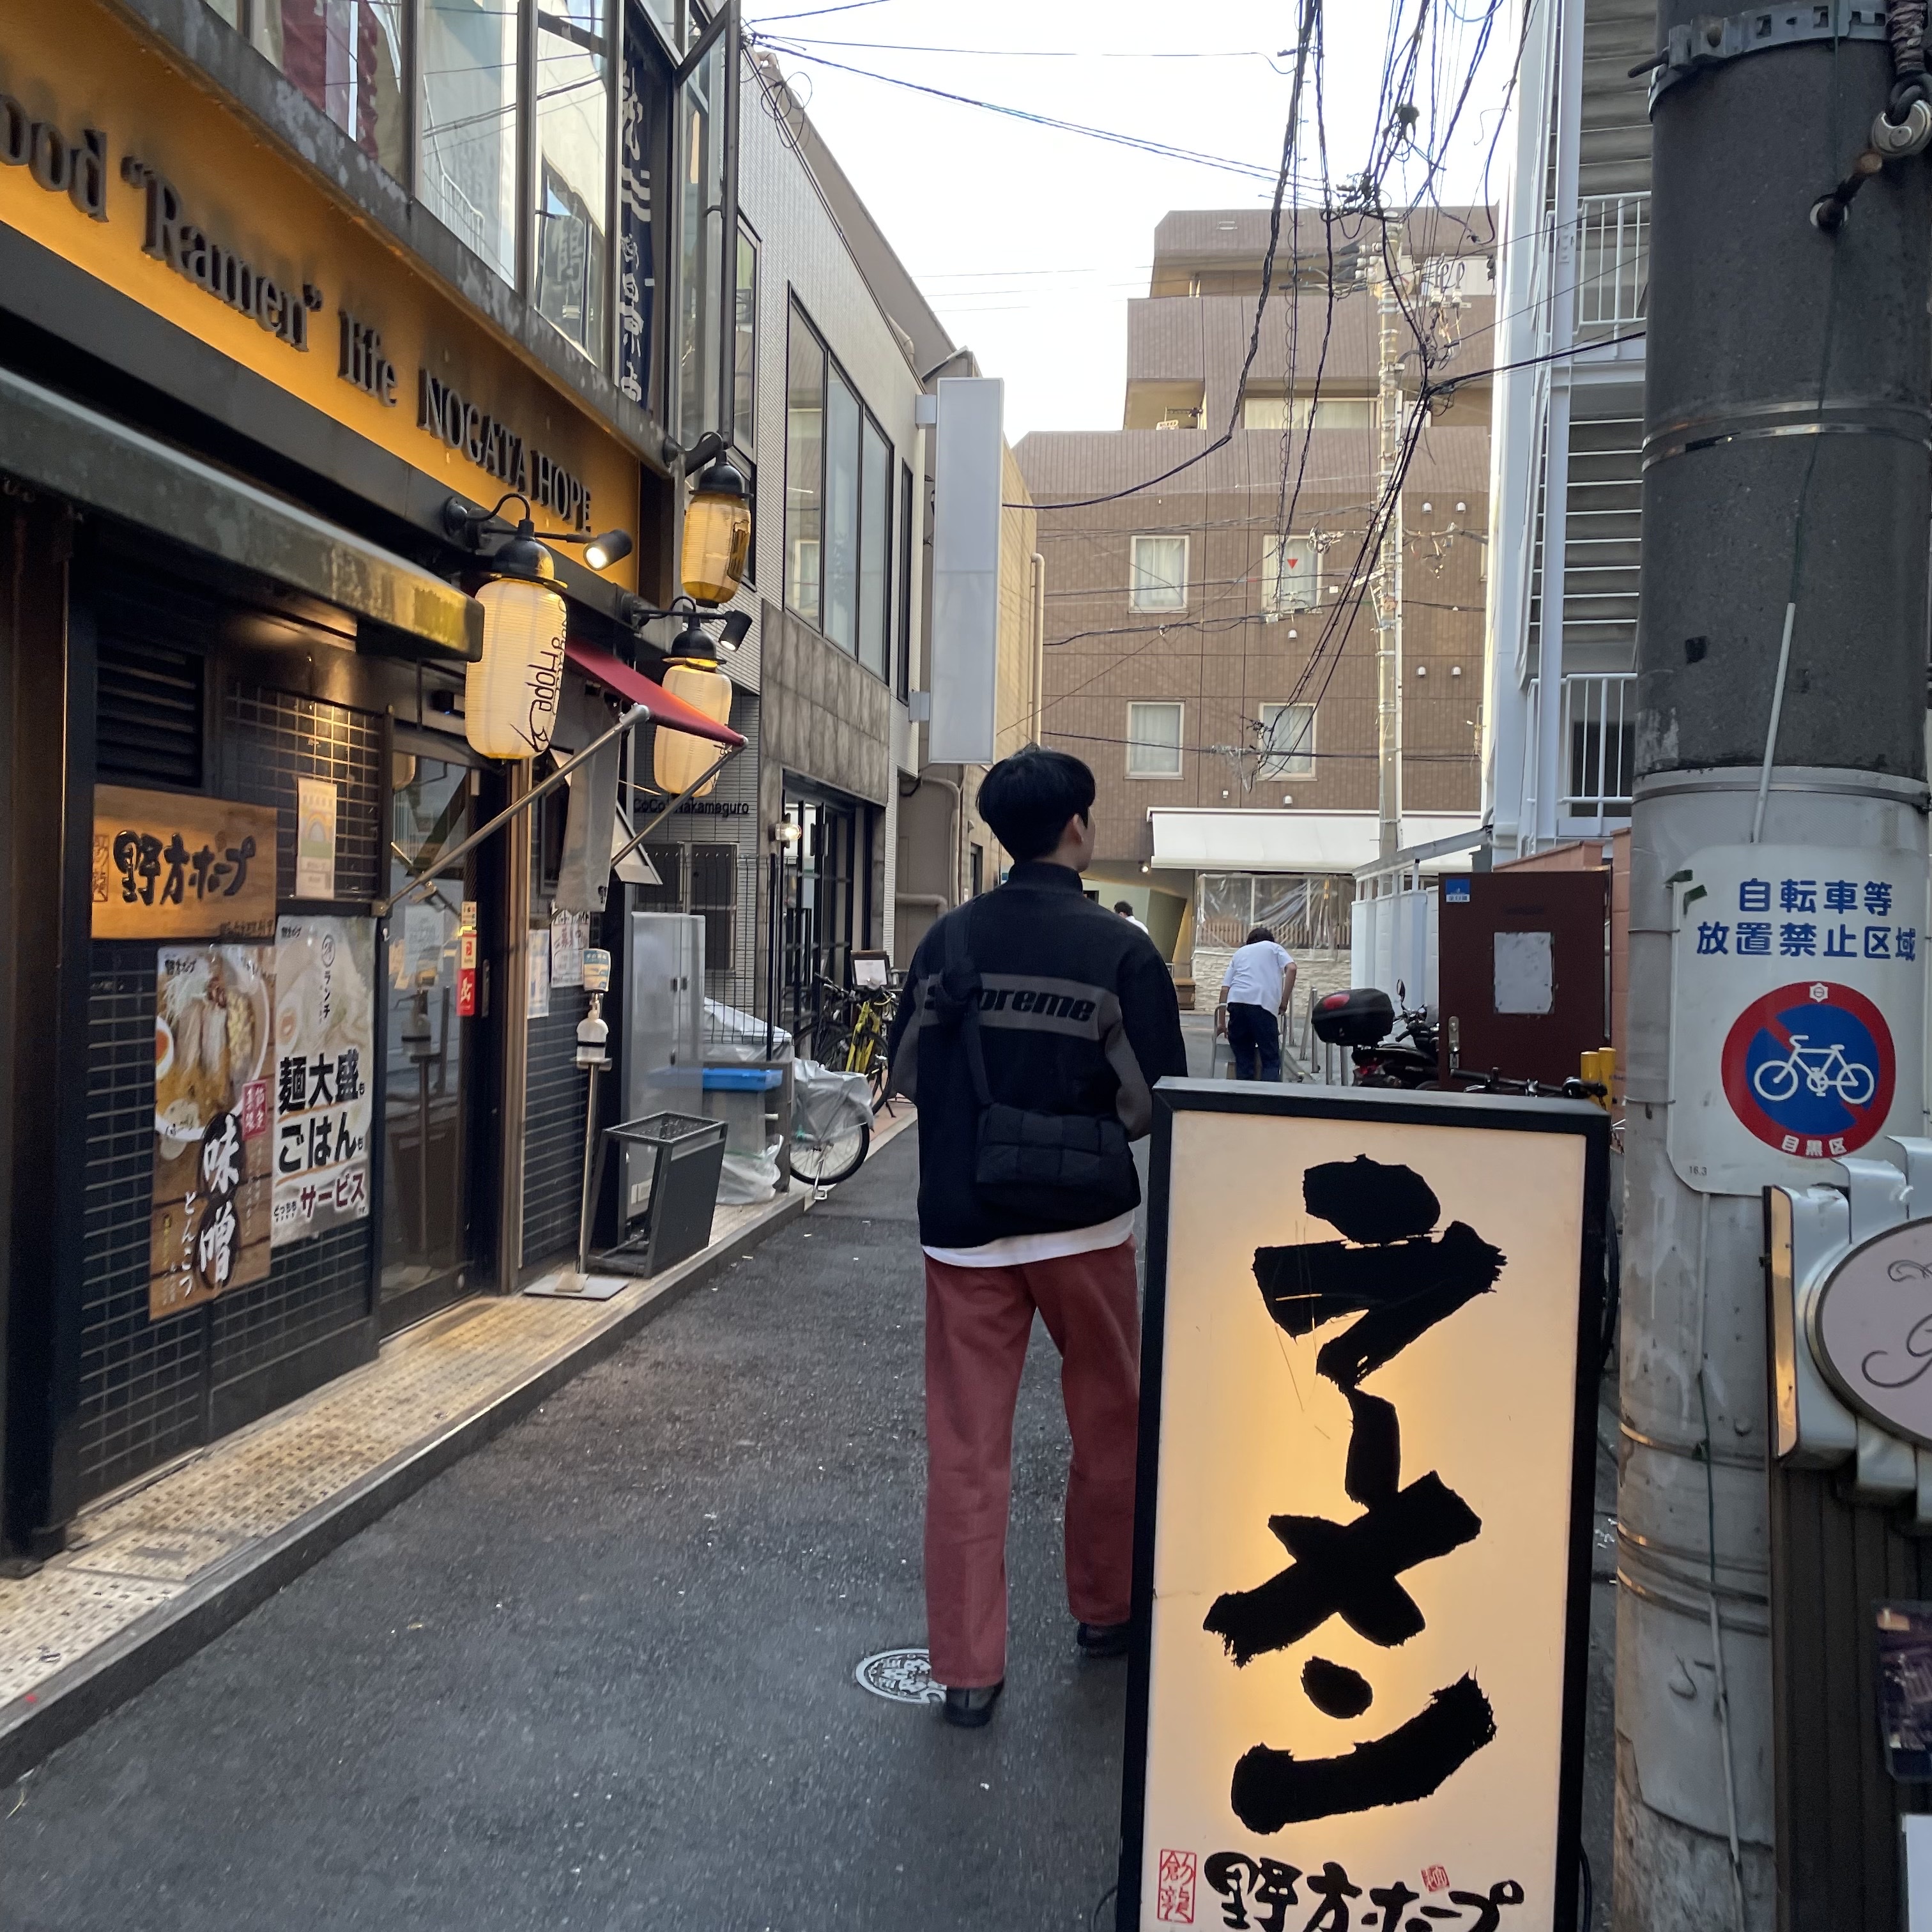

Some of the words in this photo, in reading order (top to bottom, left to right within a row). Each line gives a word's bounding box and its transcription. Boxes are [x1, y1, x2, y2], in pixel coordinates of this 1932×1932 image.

[337, 309, 398, 408] life
[417, 368, 531, 497] NOGATA
[530, 450, 591, 536] HOPE
[113, 830, 256, 906] 野方ホープ
[1739, 878, 1892, 917] 自転車等
[1697, 921, 1916, 961] 放置禁止区域
[323, 970, 331, 1018] ランチ
[1782, 1135, 1847, 1156] 目黒区
[300, 1173, 365, 1218] サービス
[179, 1191, 196, 1298] とんこつ
[1203, 1154, 1508, 1835] ラーメン
